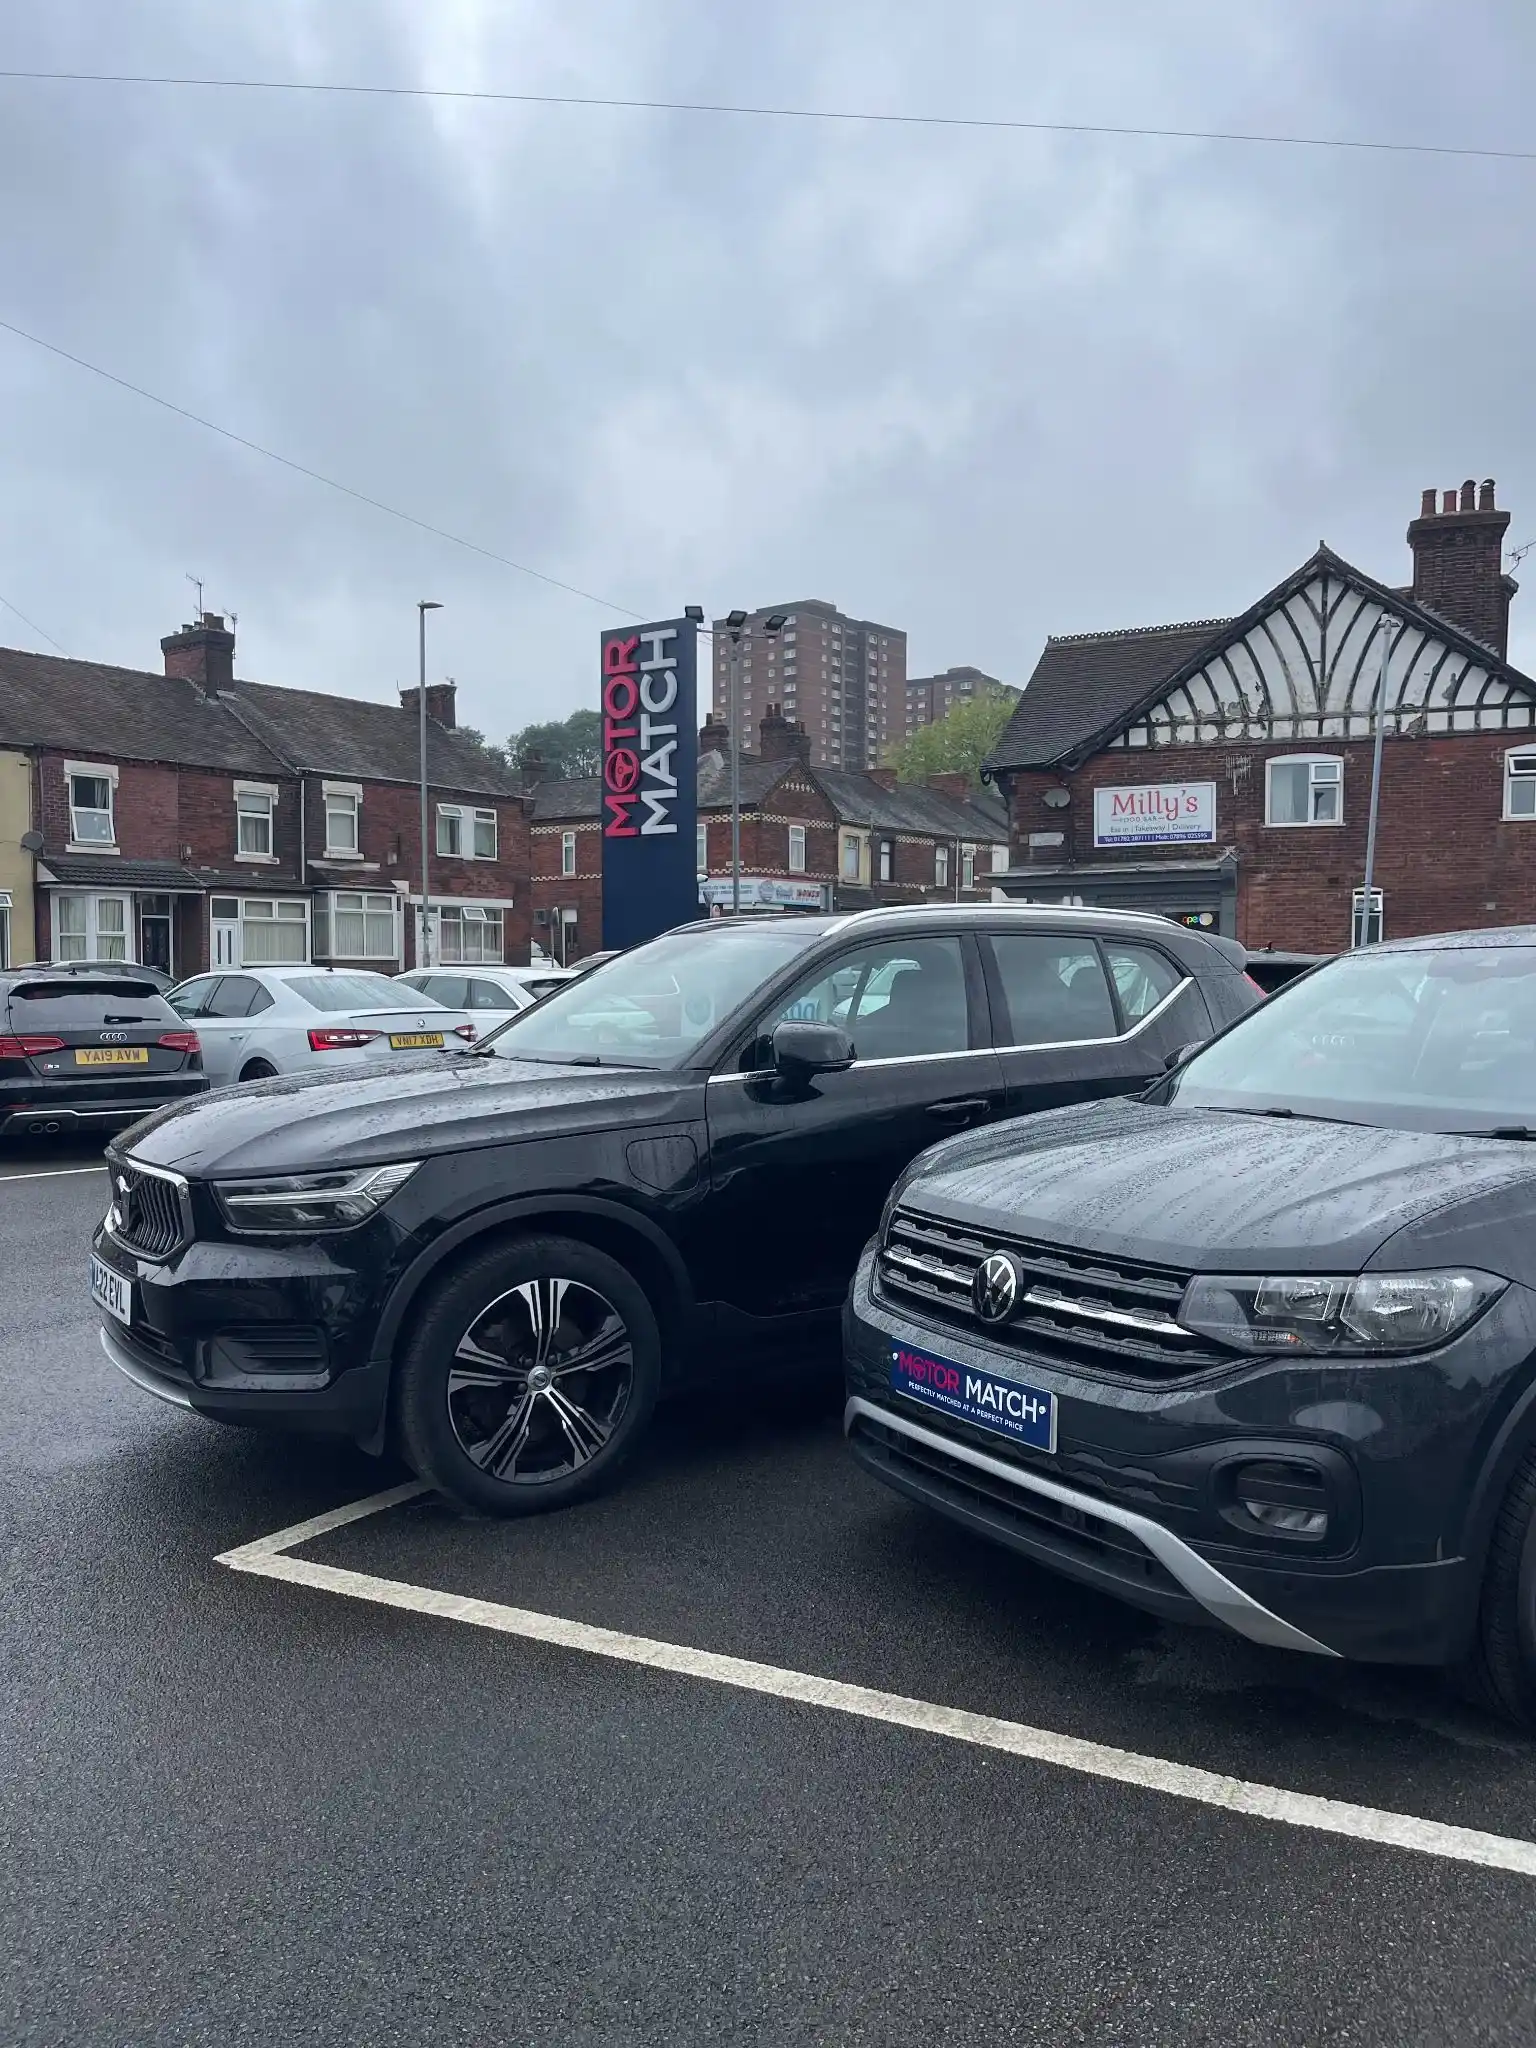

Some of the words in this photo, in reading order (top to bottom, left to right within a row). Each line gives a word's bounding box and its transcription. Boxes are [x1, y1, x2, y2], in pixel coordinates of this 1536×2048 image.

[604, 634, 640, 837] MOTOR
[639, 628, 678, 836] MATCH
[1111, 789, 1198, 821] Milly's
[84, 1050, 113, 1062] YA19
[116, 1049, 140, 1060] AVW
[396, 1035, 417, 1045] VN17
[419, 1034, 439, 1044] XDH
[109, 1274, 126, 1315] EYL
[899, 1351, 960, 1395] MOTOR
[966, 1375, 1038, 1424] MATCH
[908, 1380, 936, 1398] PERFECTLY
[936, 1392, 962, 1409] MATCHED
[962, 1403, 970, 1412] AT
[976, 1408, 1004, 1425] PERFECT
[1004, 1419, 1025, 1432] PRICE
